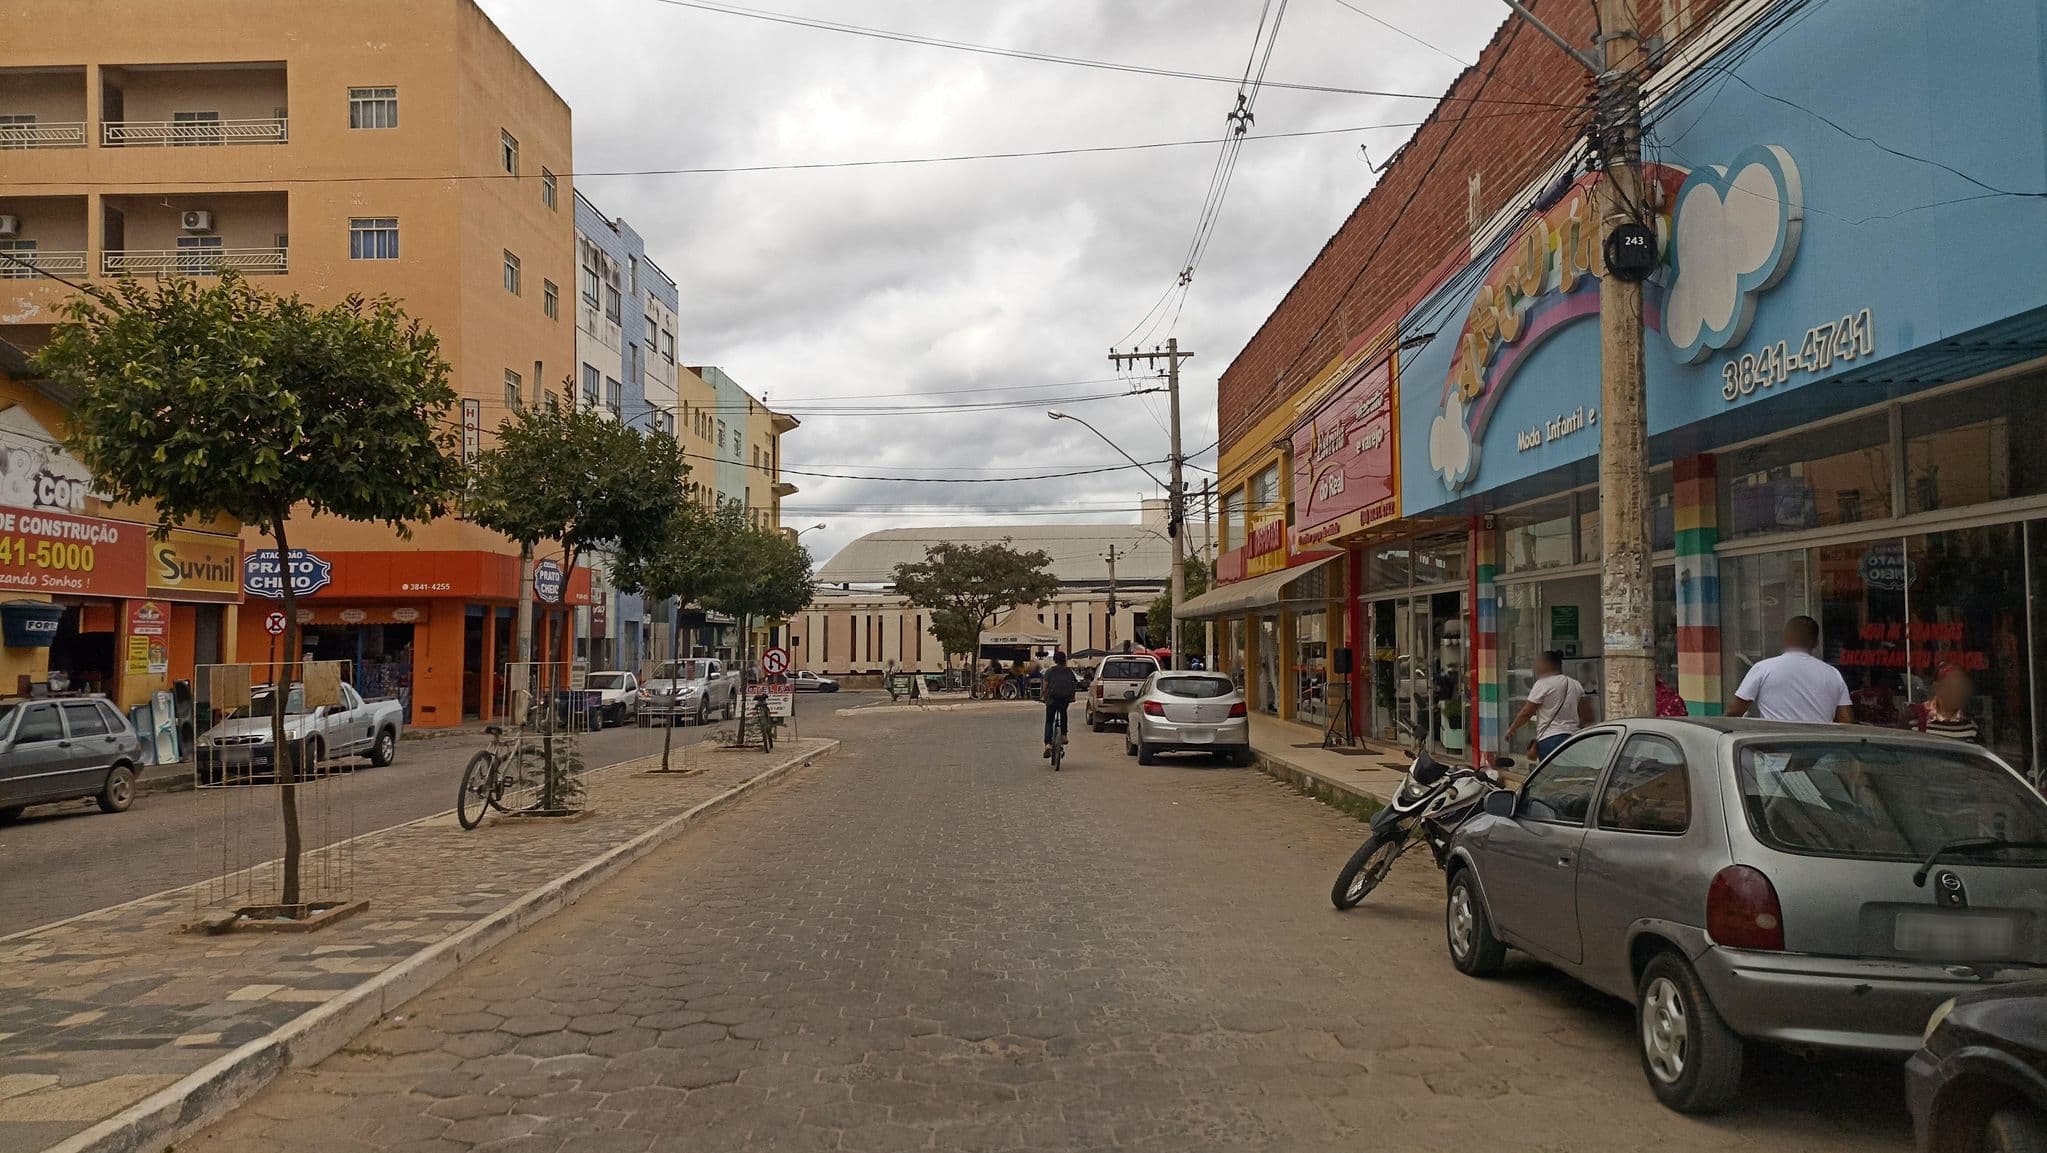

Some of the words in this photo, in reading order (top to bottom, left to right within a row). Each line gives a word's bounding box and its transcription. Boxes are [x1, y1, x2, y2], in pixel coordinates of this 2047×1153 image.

[1625, 236, 1644, 246] 243
[1722, 308, 1874, 401] 3841-4741
[1518, 426, 1541, 452] Moda
[1546, 406, 1583, 442] Infantil
[1588, 407, 1596, 424] e
[1329, 468, 1345, 497] Real
[19, 515, 118, 546] CONSTRUÇÃO
[159, 548, 235, 582] Suvinil
[260, 550, 303, 559] ATACDÃO
[41, 574, 83, 588] Sonhos
[540, 571, 560, 581] PRATO
